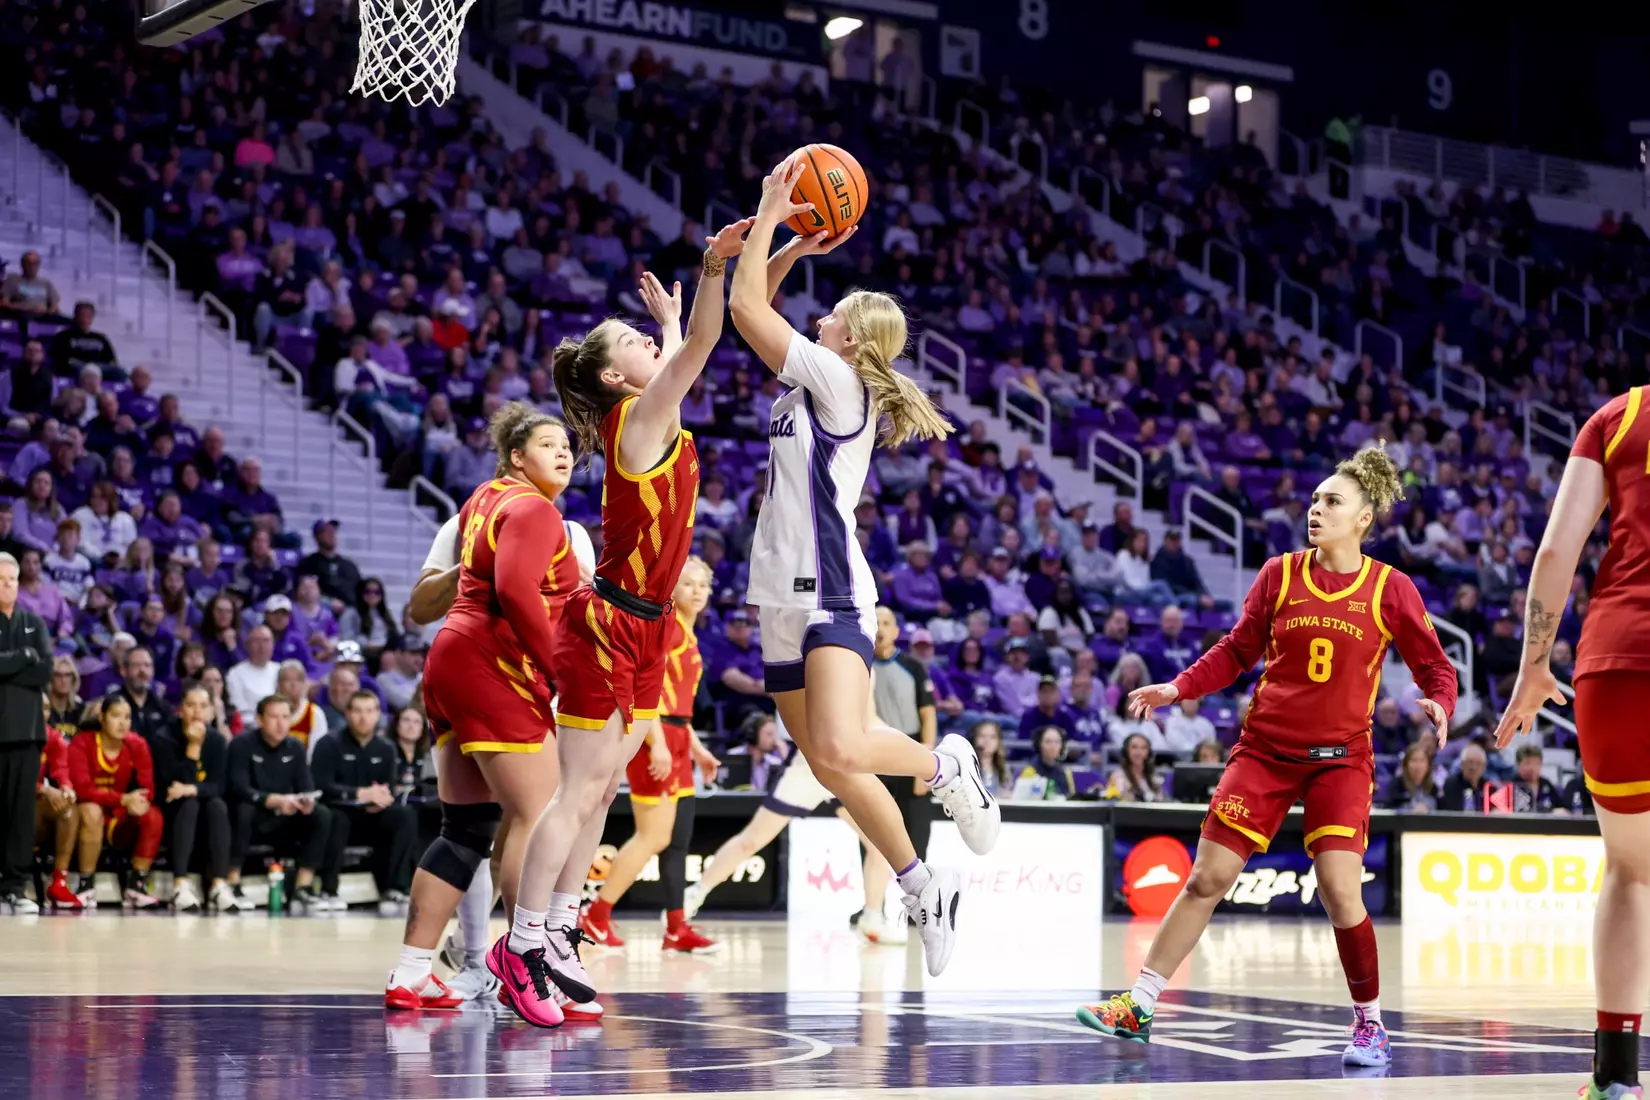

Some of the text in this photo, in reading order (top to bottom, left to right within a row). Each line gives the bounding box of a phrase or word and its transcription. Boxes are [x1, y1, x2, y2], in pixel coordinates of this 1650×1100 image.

[1019, 0, 1050, 40] 8
[1428, 69, 1452, 110] 9
[1285, 616, 1364, 641] IOWA STATE
[1307, 637, 1334, 683] 8
[1217, 801, 1251, 819] STATE
